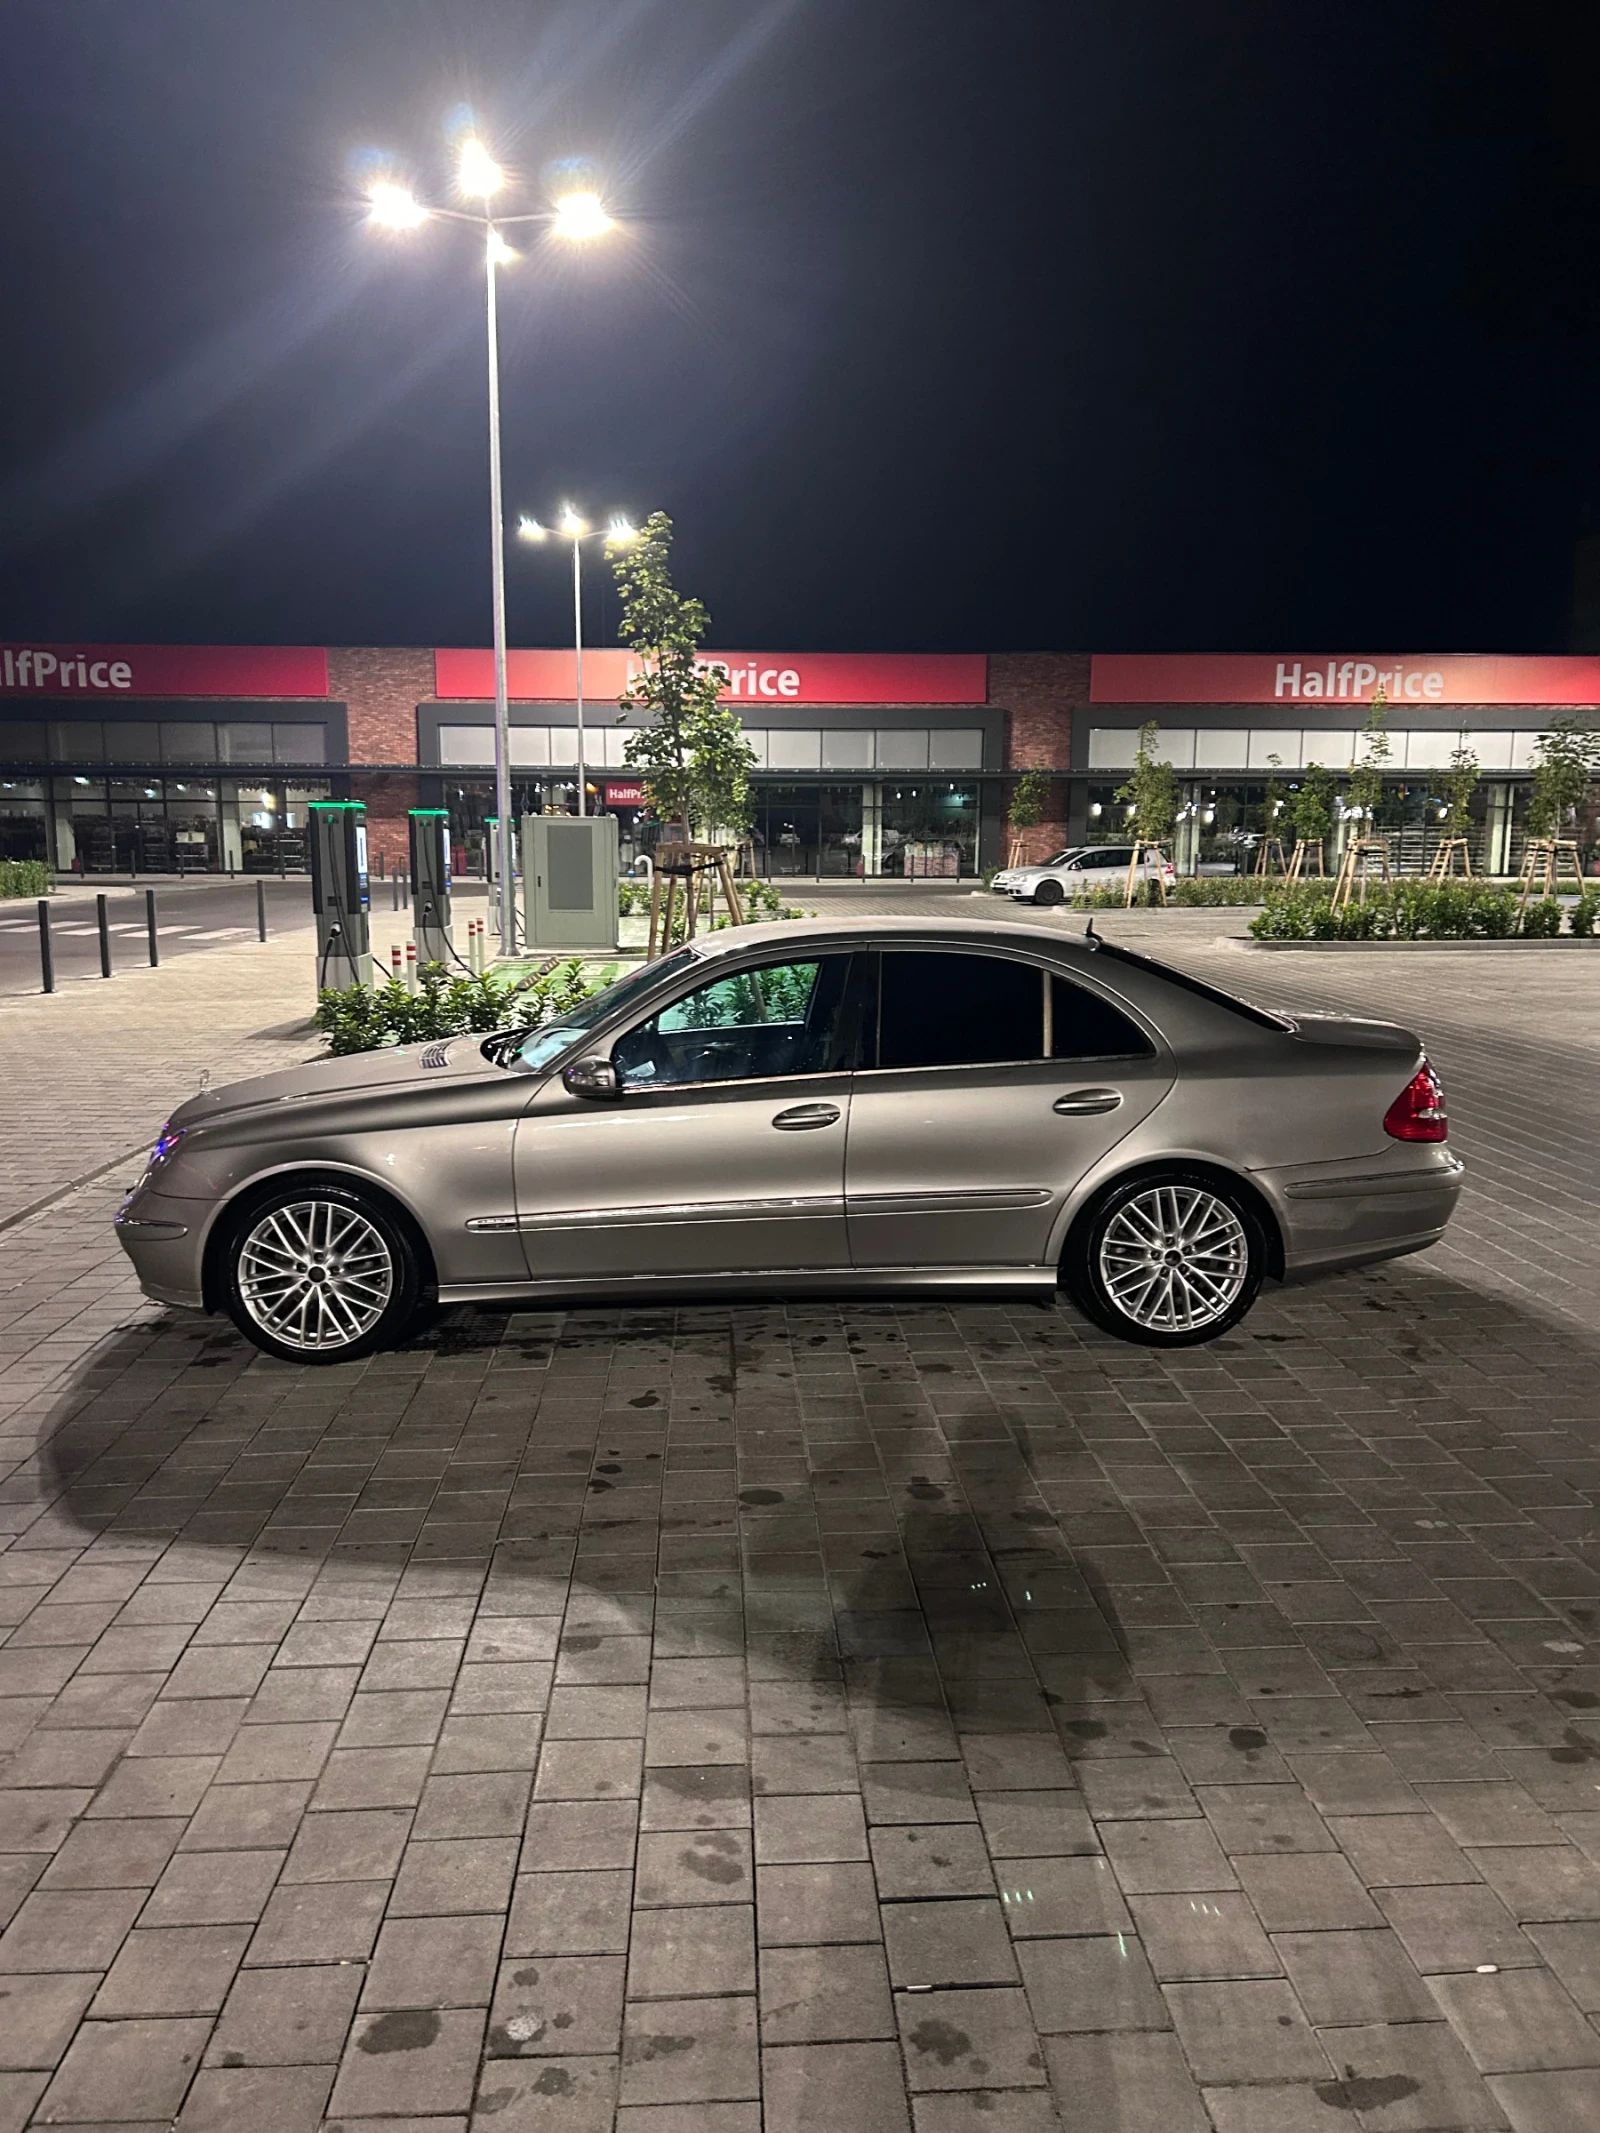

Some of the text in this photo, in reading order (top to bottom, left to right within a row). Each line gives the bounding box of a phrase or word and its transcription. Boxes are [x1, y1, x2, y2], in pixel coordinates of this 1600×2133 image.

[0, 649, 133, 689] lfPrice
[1275, 661, 1444, 698] HalfPrice
[609, 788, 645, 799] HalfPr
